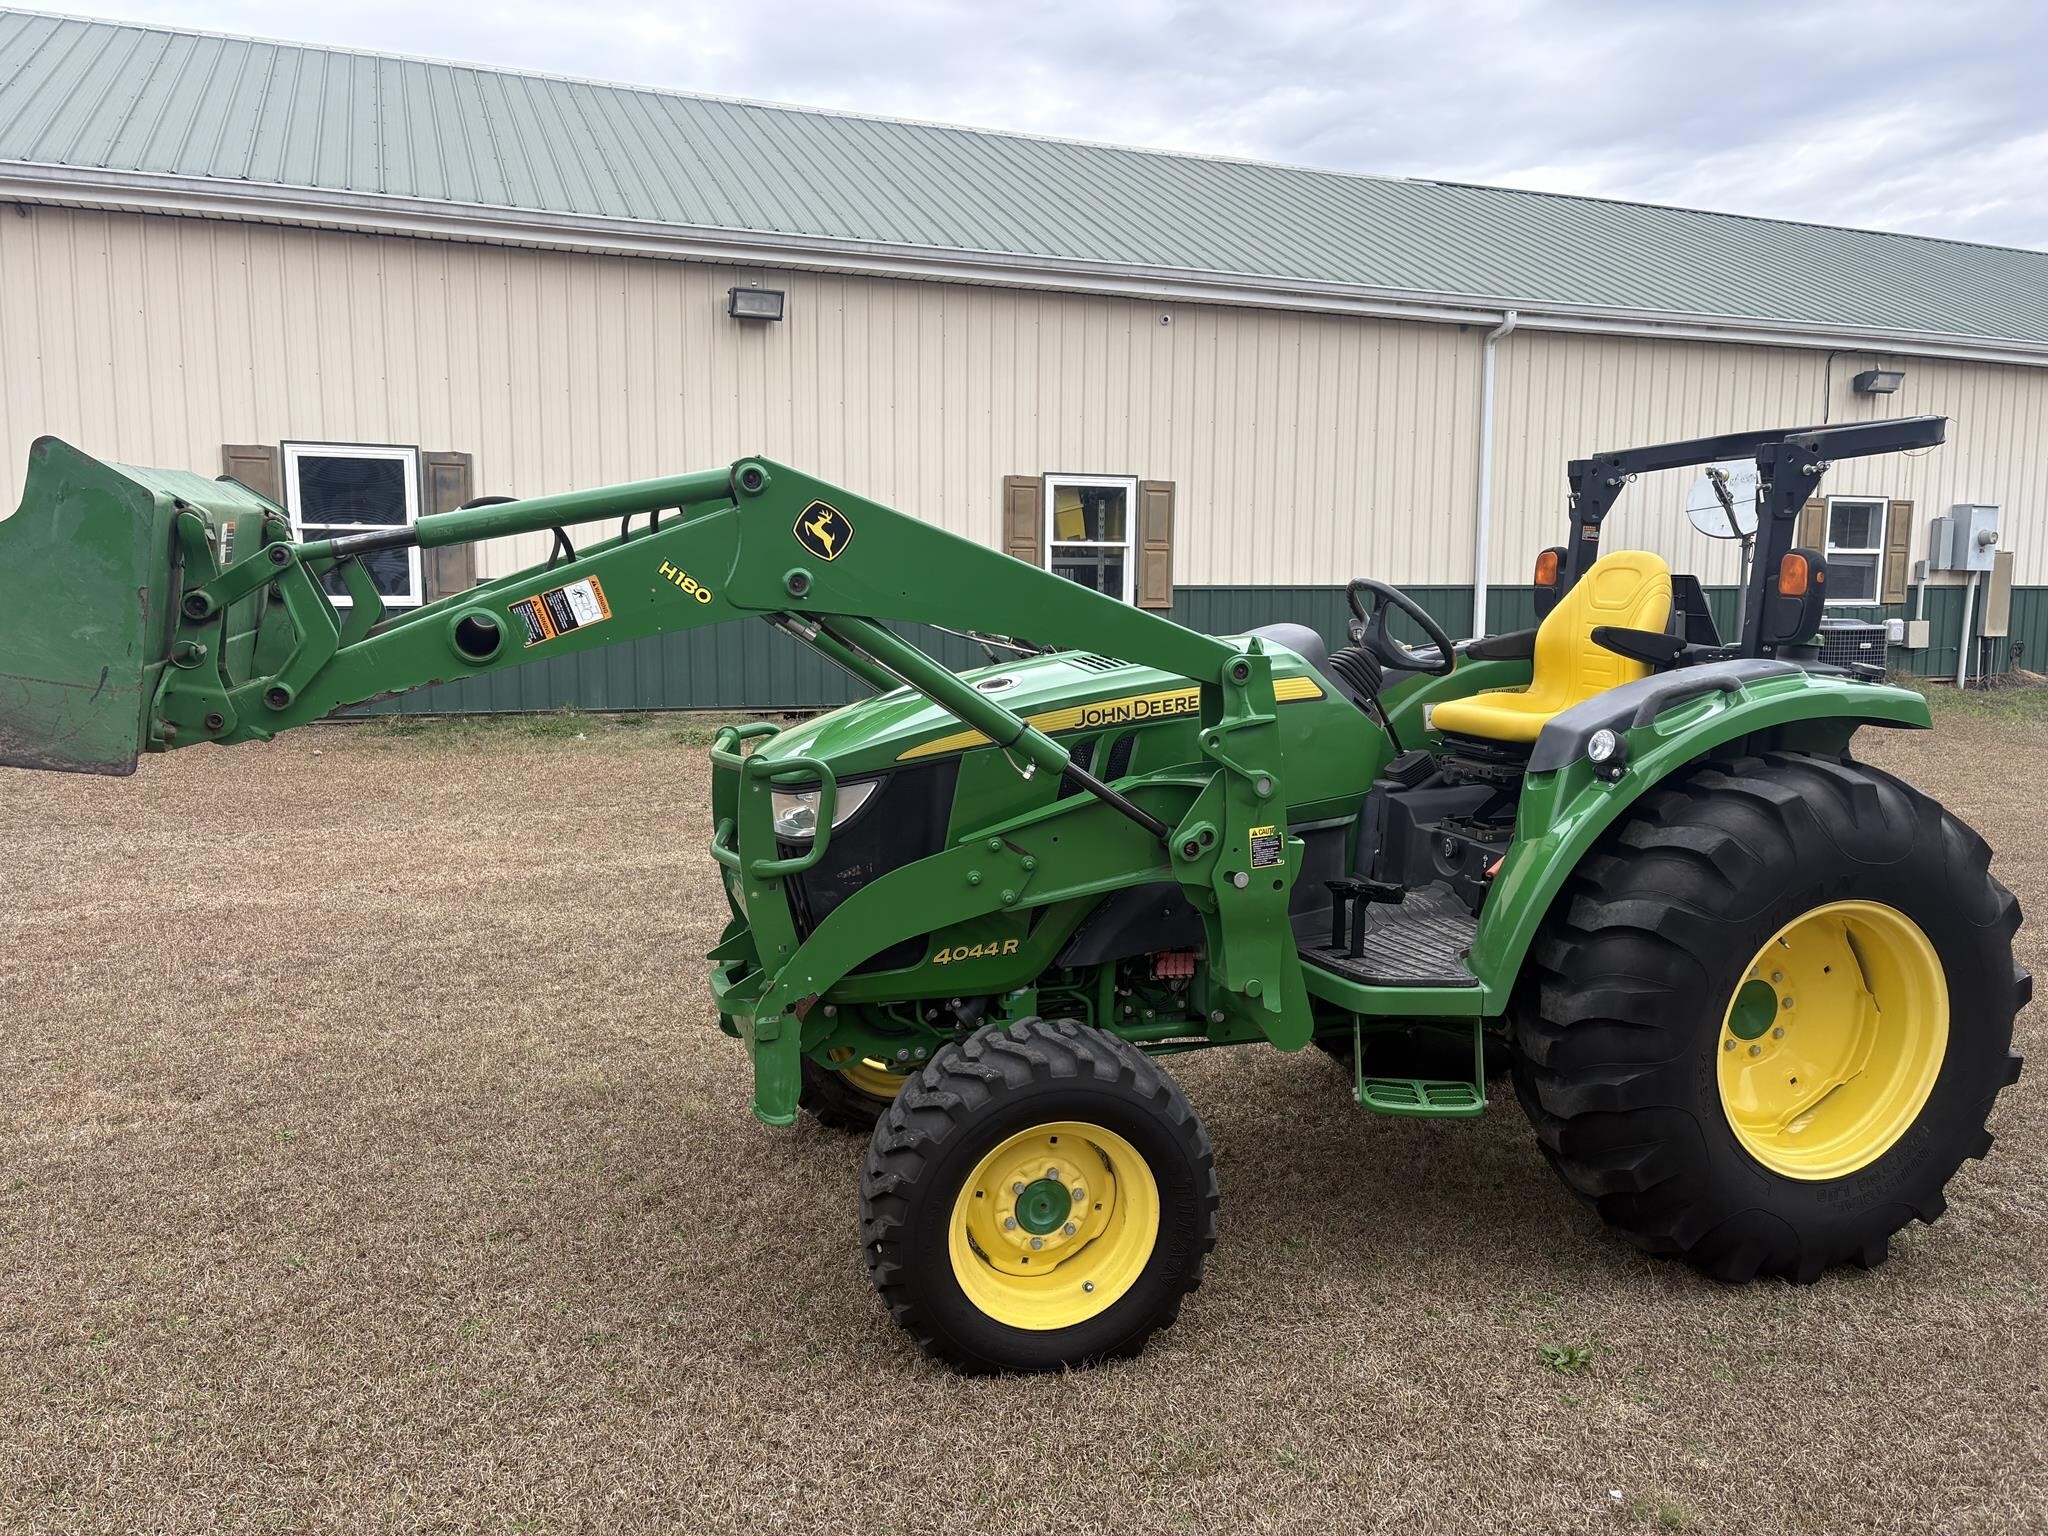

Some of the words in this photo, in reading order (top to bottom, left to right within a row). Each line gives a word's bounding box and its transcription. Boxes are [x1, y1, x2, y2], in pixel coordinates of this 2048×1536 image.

[658, 560, 713, 604] H180
[595, 586, 609, 614] WARNING
[536, 607, 551, 635] WARNING
[1074, 704, 1131, 728] JOHN
[1134, 695, 1200, 717] DEERE
